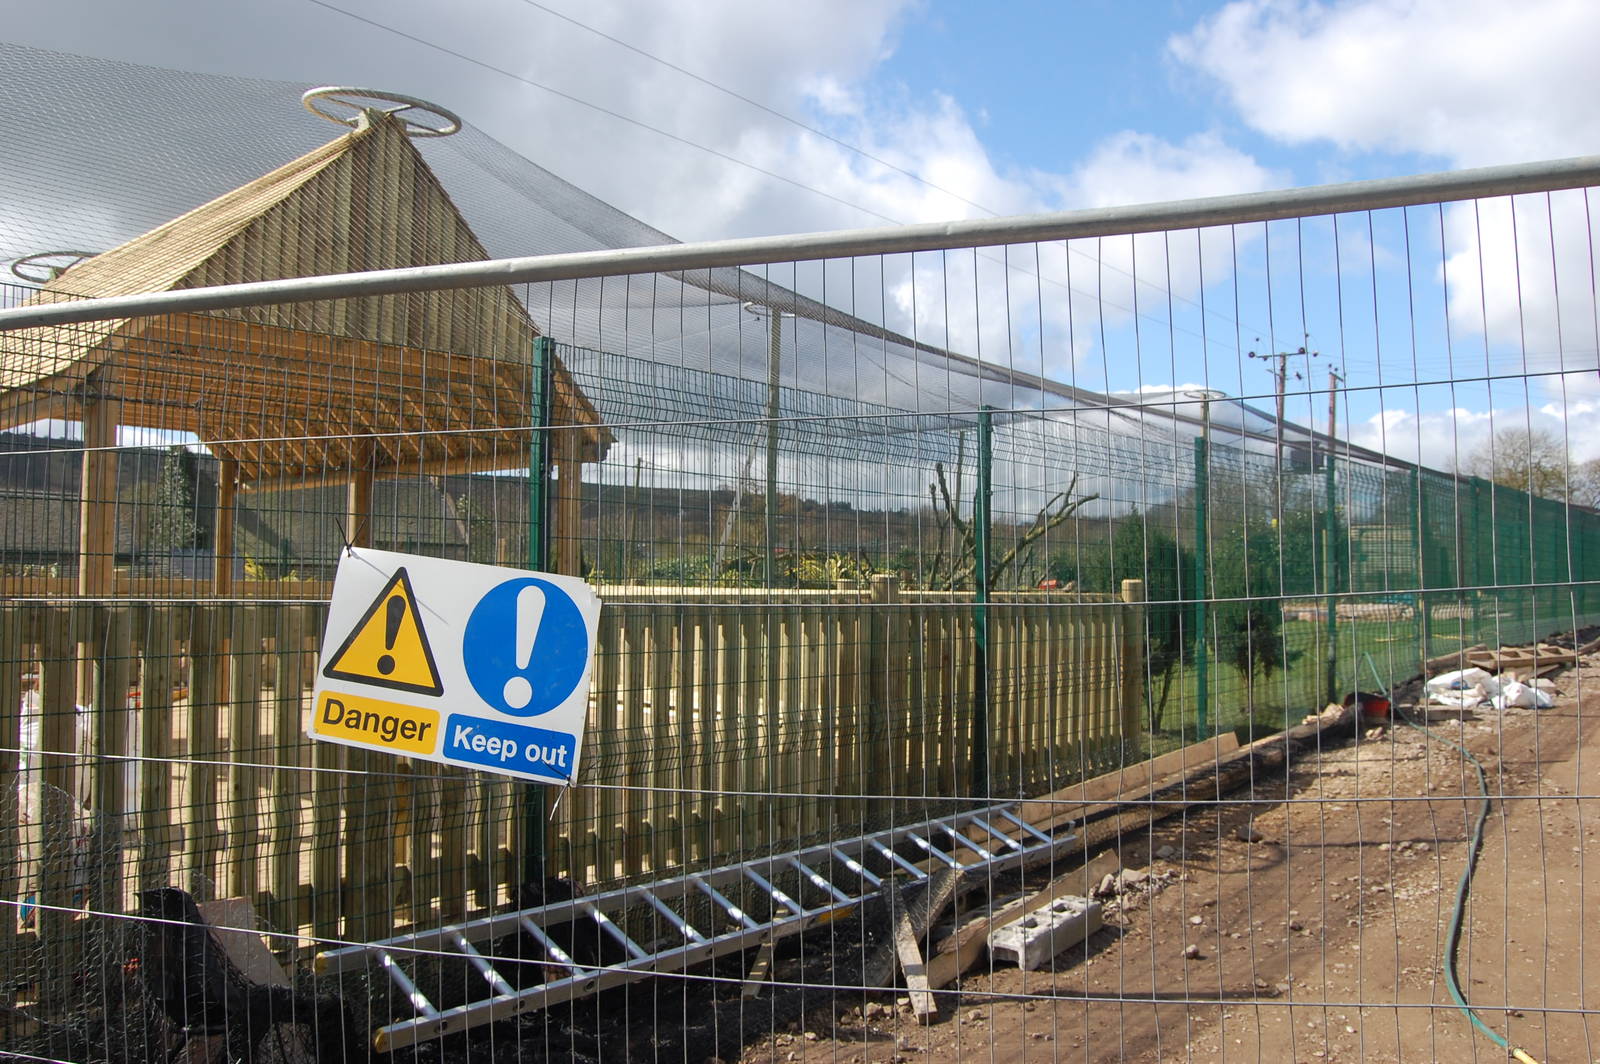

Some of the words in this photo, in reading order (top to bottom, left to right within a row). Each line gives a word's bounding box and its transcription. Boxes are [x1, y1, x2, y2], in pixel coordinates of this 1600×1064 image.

[322, 698, 432, 742] Danger
[453, 724, 518, 761] Keep
[525, 744, 568, 768] out
